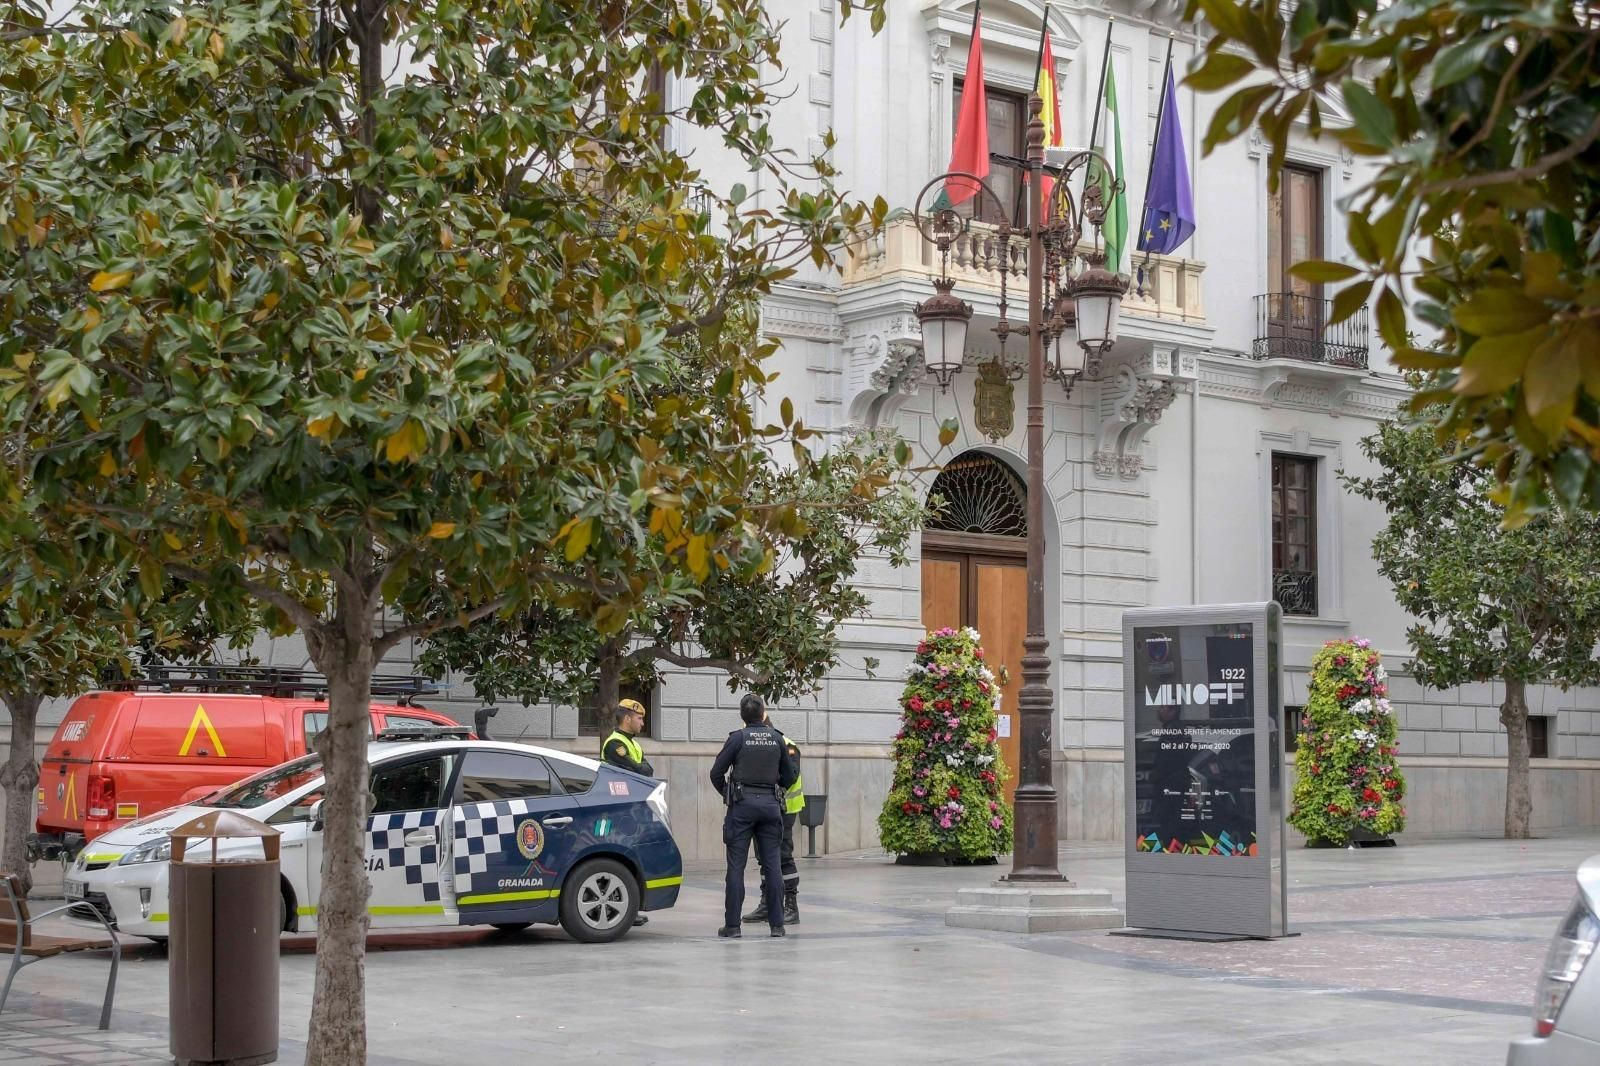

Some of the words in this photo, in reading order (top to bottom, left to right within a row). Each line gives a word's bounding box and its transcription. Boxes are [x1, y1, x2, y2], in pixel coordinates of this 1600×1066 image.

[1220, 668, 1246, 680] 1922
[1145, 682, 1245, 706] MILNOFF
[61, 721, 85, 742] UME
[1151, 728, 1182, 736] GRANADA
[1183, 728, 1204, 736] SIENTE
[1205, 728, 1241, 736] FLAMENCO
[1160, 742, 1172, 750] Del
[1172, 742, 1177, 750] 2
[1178, 742, 1184, 750] al
[1190, 742, 1198, 750] de
[1198, 742, 1213, 751] junio
[1214, 742, 1231, 750] 2020
[497, 877, 544, 889] GRANADA
